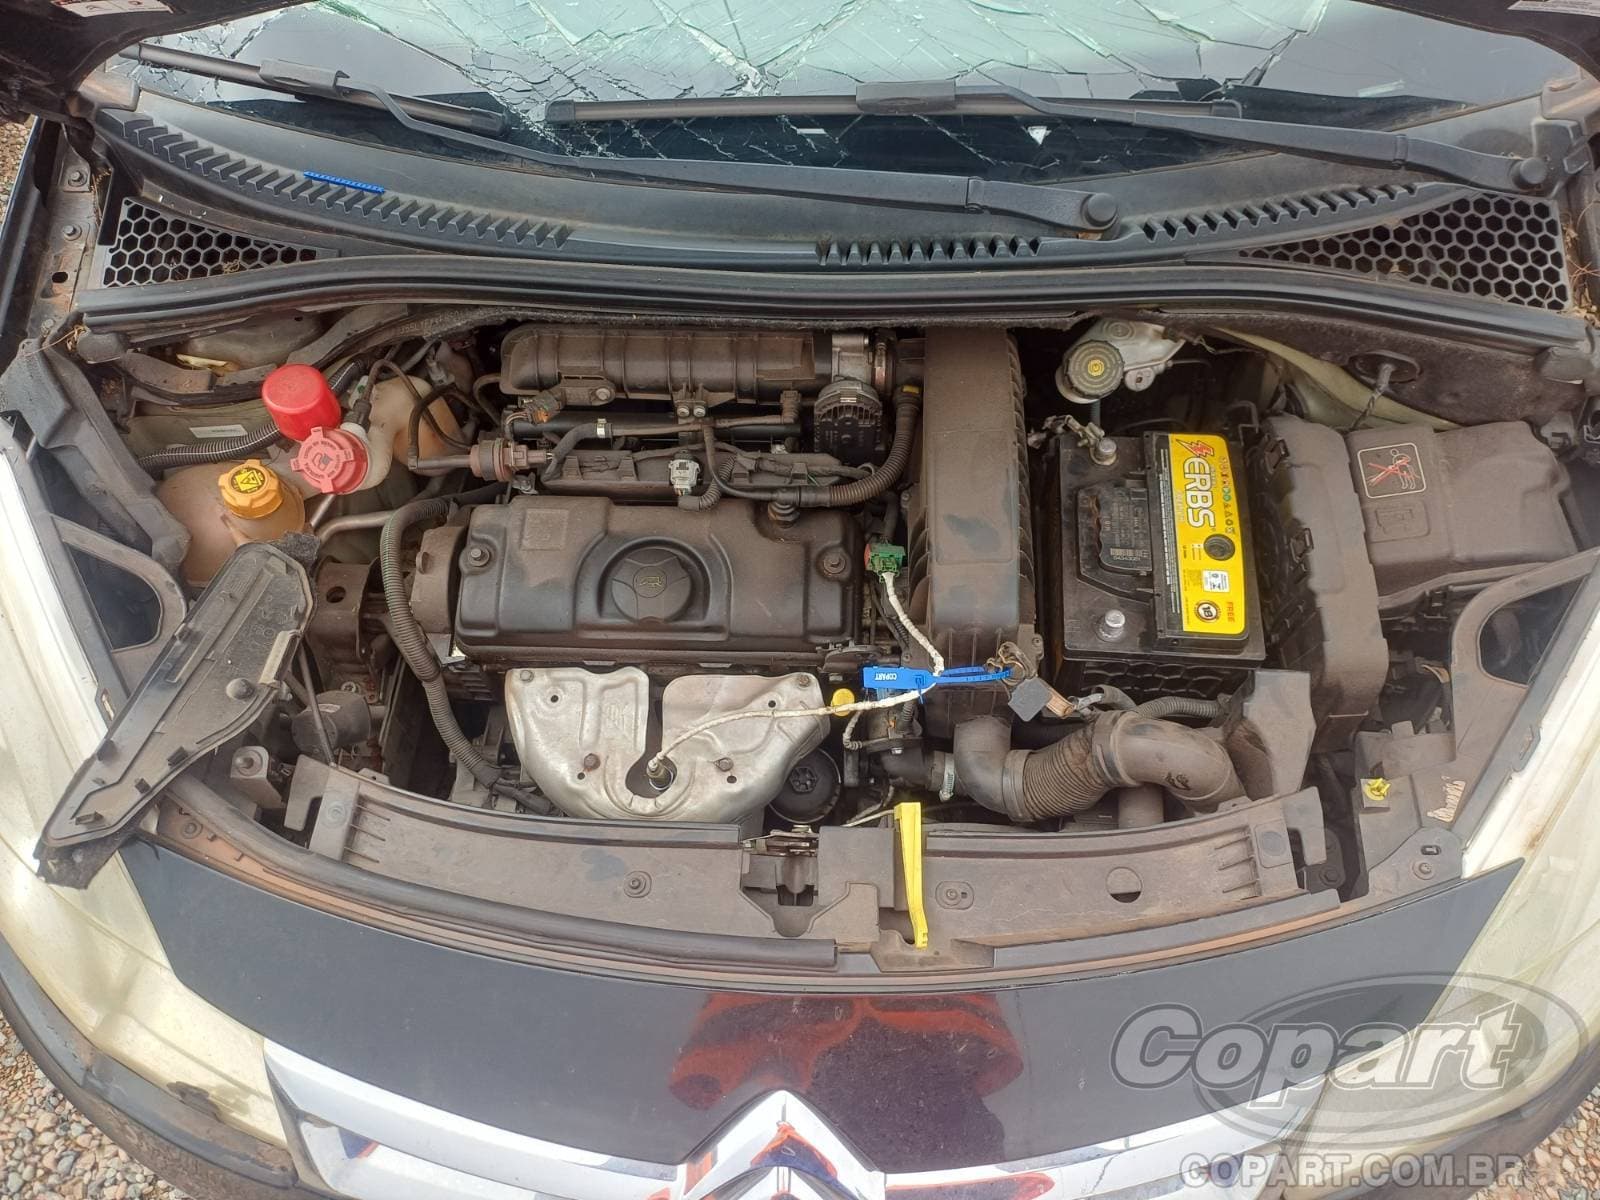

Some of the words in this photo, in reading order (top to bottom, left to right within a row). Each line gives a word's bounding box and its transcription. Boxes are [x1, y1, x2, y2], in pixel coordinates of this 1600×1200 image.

[1183, 457, 1215, 528] ERBS
[1226, 601, 1235, 623] FREE
[875, 673, 897, 681] COPART
